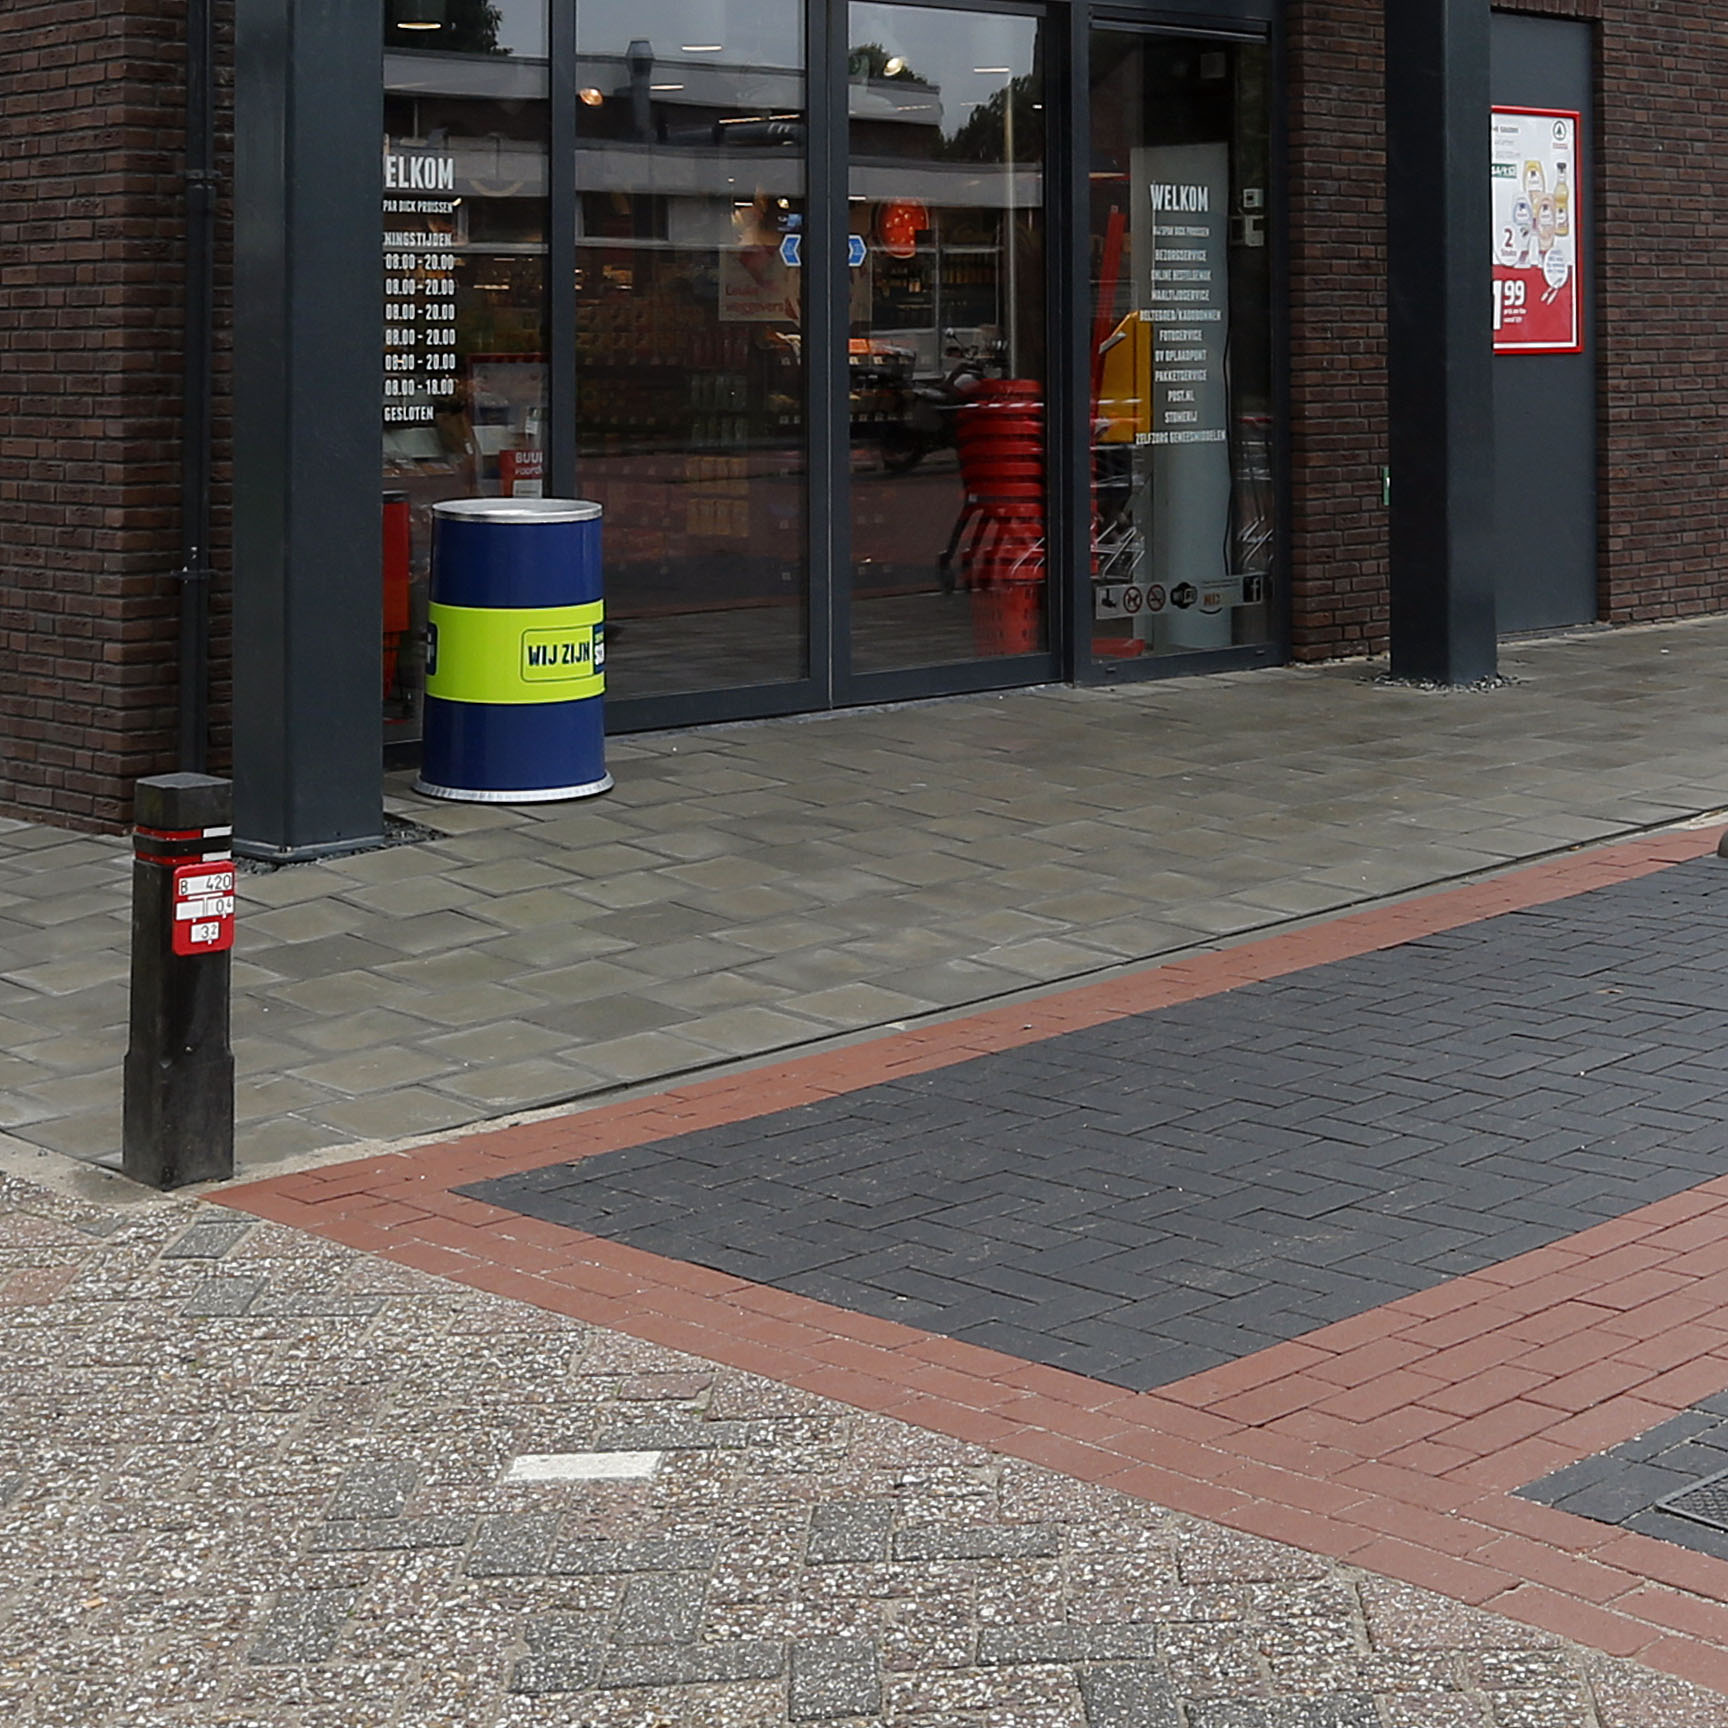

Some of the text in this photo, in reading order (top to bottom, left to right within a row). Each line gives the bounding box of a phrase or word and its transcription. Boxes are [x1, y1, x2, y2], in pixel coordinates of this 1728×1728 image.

[1150, 184, 1209, 211] WELKOM
[1504, 228, 1513, 248] 2
[385, 254, 416, 270] 08.00
[425, 254, 455, 270] 20.00
[385, 279, 416, 295] 08.00
[425, 279, 455, 295] 20.00
[385, 304, 416, 320] 08.00
[425, 304, 455, 320] 20.00
[385, 329, 416, 345] 08.00
[425, 329, 455, 345] 20.00
[1159, 330, 1203, 341] FOTOSERVICE
[385, 354, 416, 370] 08.00
[425, 354, 455, 370] 20.00
[1155, 350, 1207, 362] OV OPLAADPUNT
[1155, 370, 1207, 382] PAKKETSERVICE
[385, 379, 416, 395] 08.00
[425, 379, 455, 395] 18.00
[384, 406, 434, 421] GESLOTEN
[1165, 411, 1198, 423] STOMERIJ
[1136, 432, 1169, 445] ZELFZORG
[528, 645, 558, 667] WIJ
[562, 641, 590, 665] ZIJN
[180, 874, 232, 895] B 420
